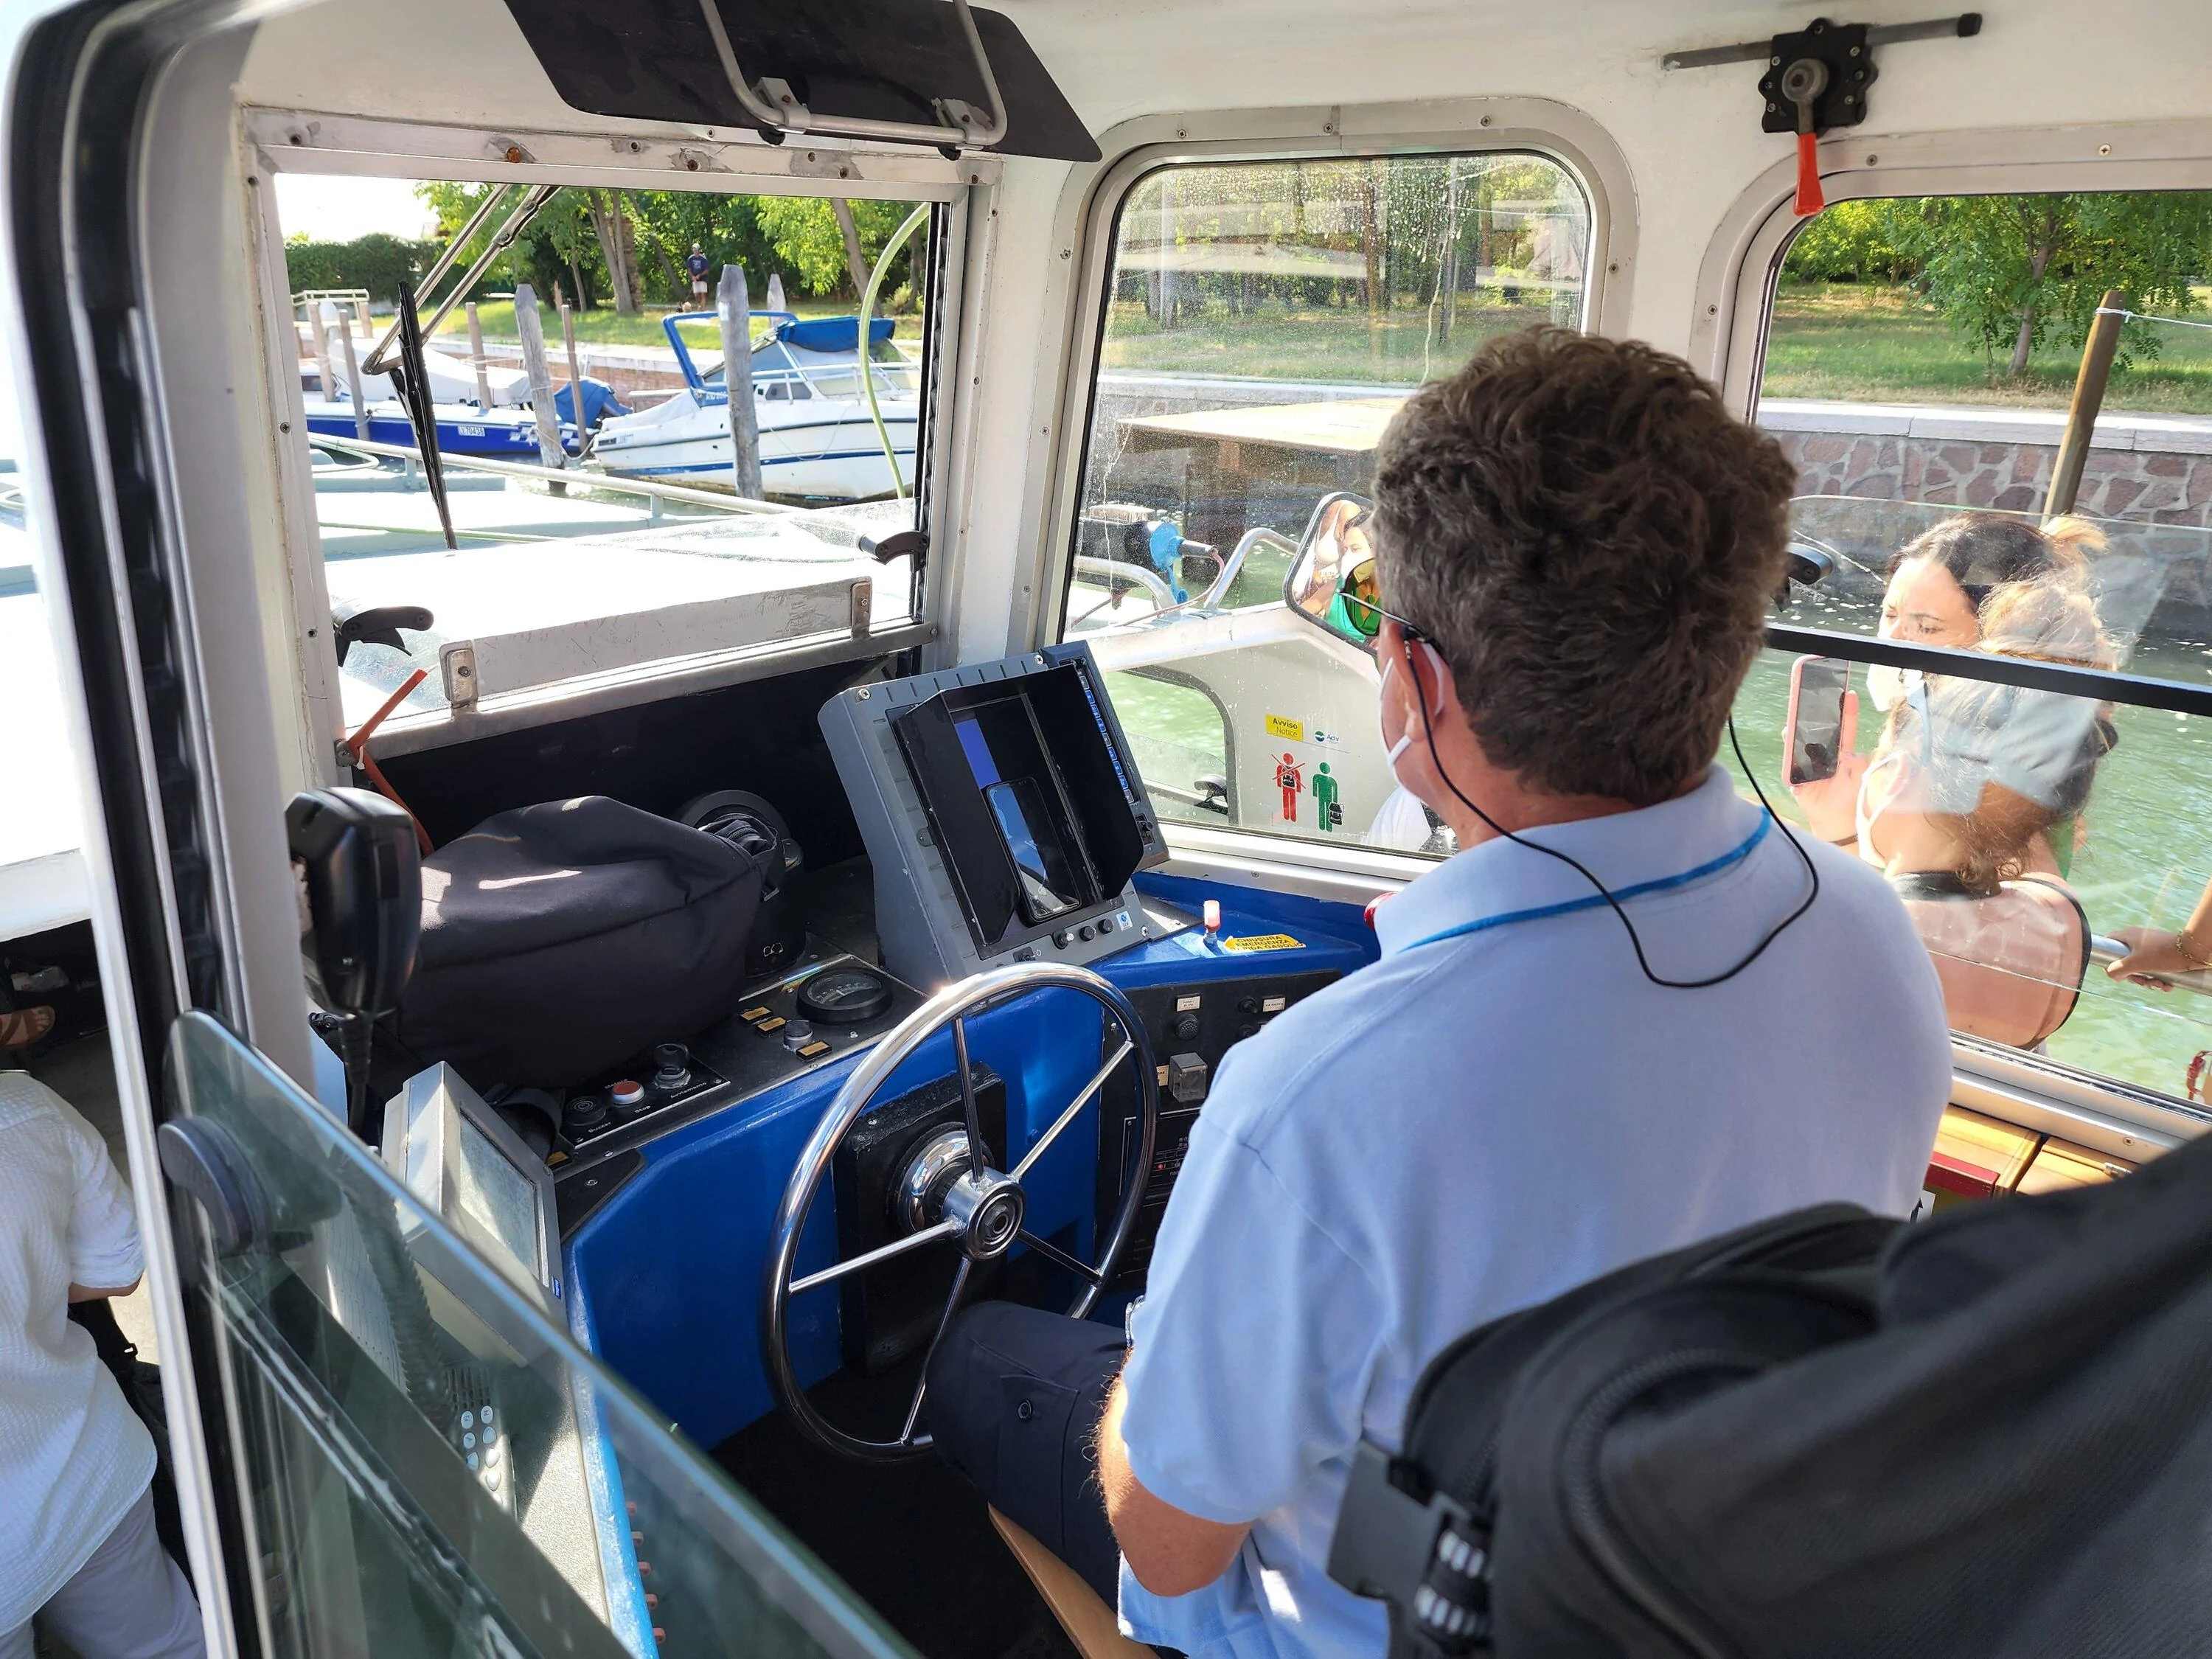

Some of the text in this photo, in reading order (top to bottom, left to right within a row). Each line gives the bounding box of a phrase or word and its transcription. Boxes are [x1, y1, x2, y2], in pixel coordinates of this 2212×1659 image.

[1272, 717, 1298, 729] Avviso
[1276, 726, 1298, 738] Notice
[1236, 939, 1291, 947] EMERGENZA
[670, 1082, 707, 1099] Avviamento
[634, 1105, 651, 1113] Stop
[588, 1121, 611, 1133] Buzzer
